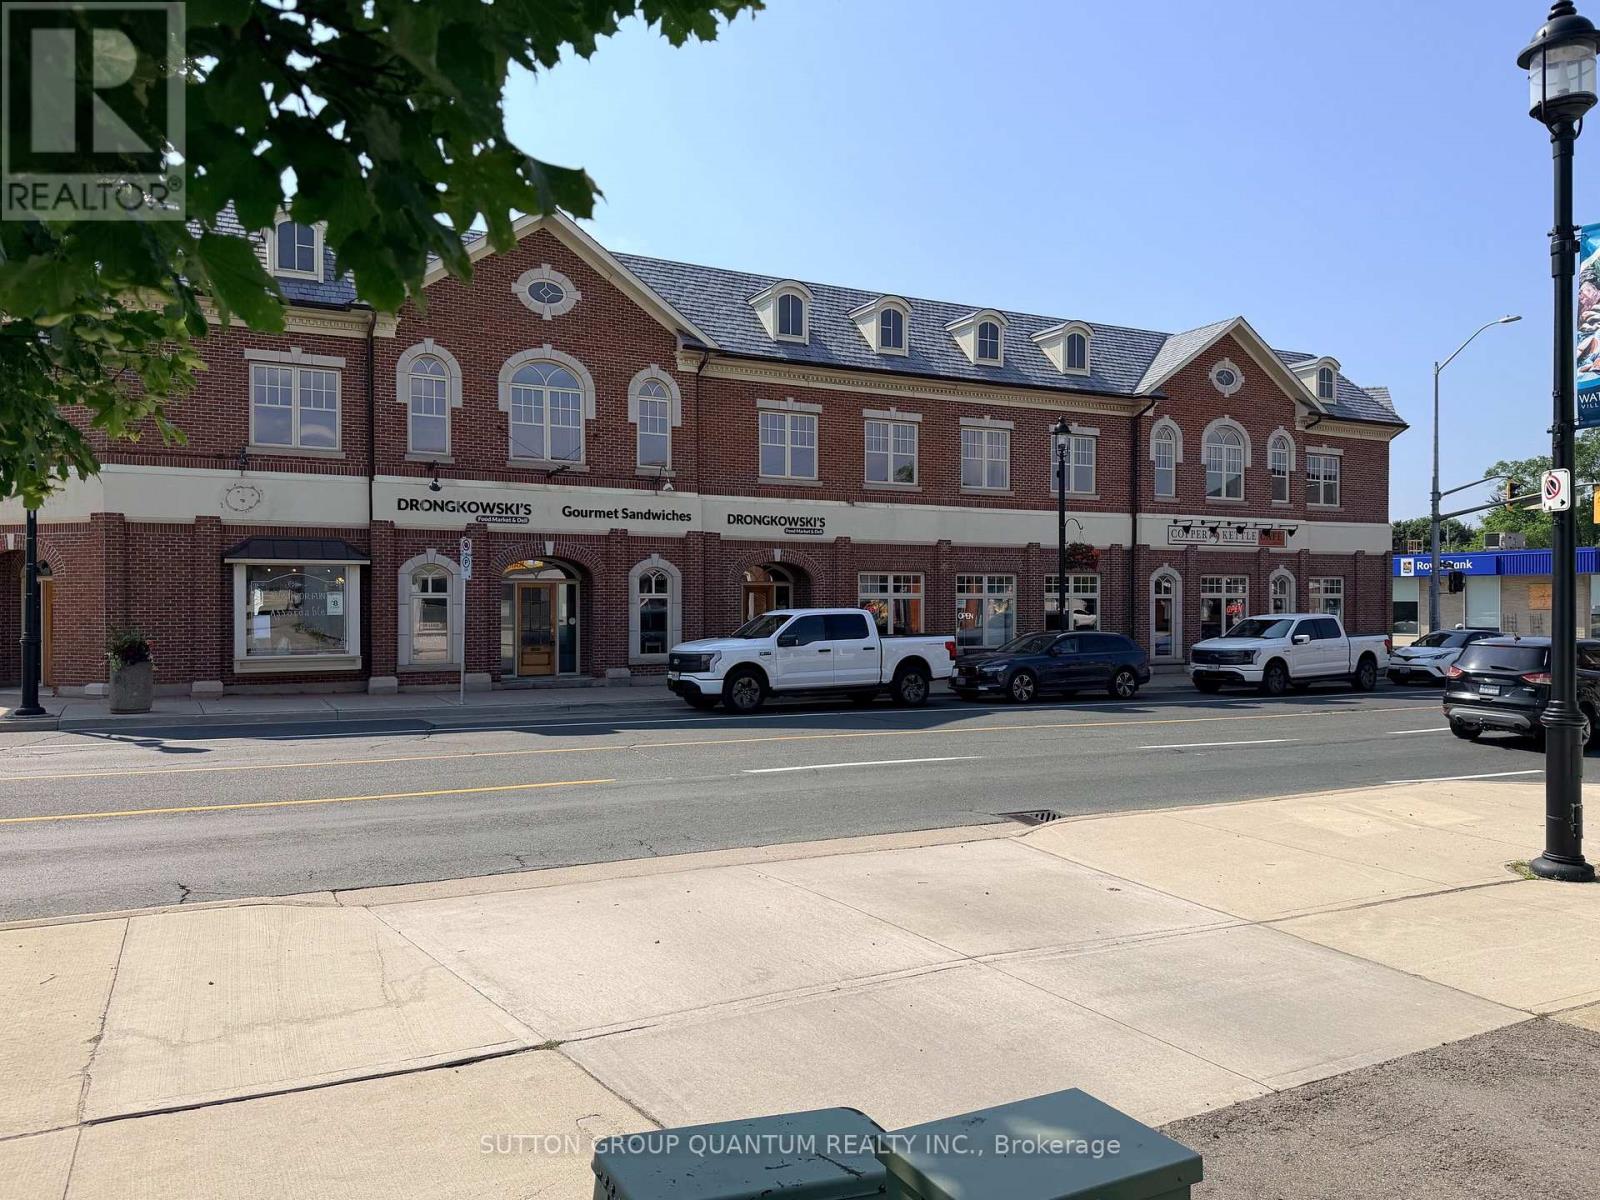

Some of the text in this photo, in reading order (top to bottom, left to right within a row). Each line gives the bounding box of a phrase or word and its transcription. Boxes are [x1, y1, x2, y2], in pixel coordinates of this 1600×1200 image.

[397, 497, 532, 516] DRONGKOWSKI'S
[562, 505, 692, 522] Gourmet Sandwiches
[727, 513, 825, 527] DRONGKOWSKI'S
